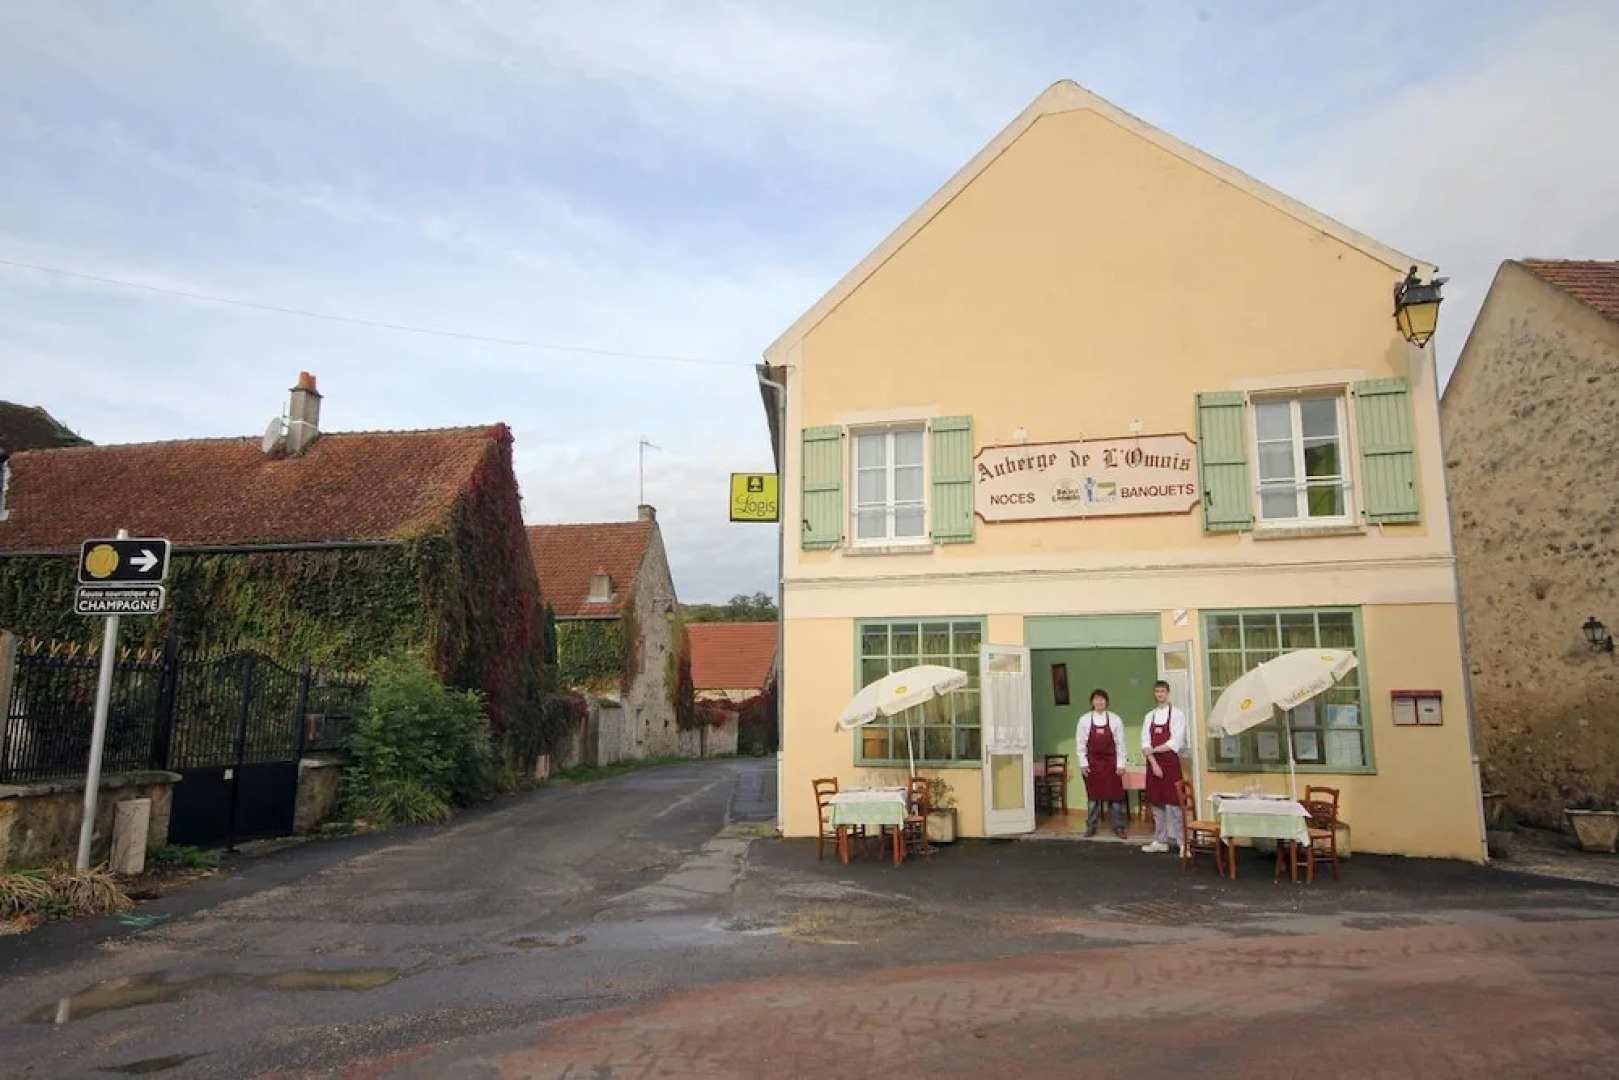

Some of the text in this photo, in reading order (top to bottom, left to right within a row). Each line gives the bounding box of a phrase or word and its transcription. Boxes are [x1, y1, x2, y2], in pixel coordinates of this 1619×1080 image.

[978, 453, 1057, 484] Auberge
[1069, 449, 1091, 468] de
[990, 491, 1036, 505] NOCES
[1121, 483, 1195, 499] BANQUETS
[735, 493, 776, 517] Logis
[79, 600, 158, 611] CHAMPAGNE
